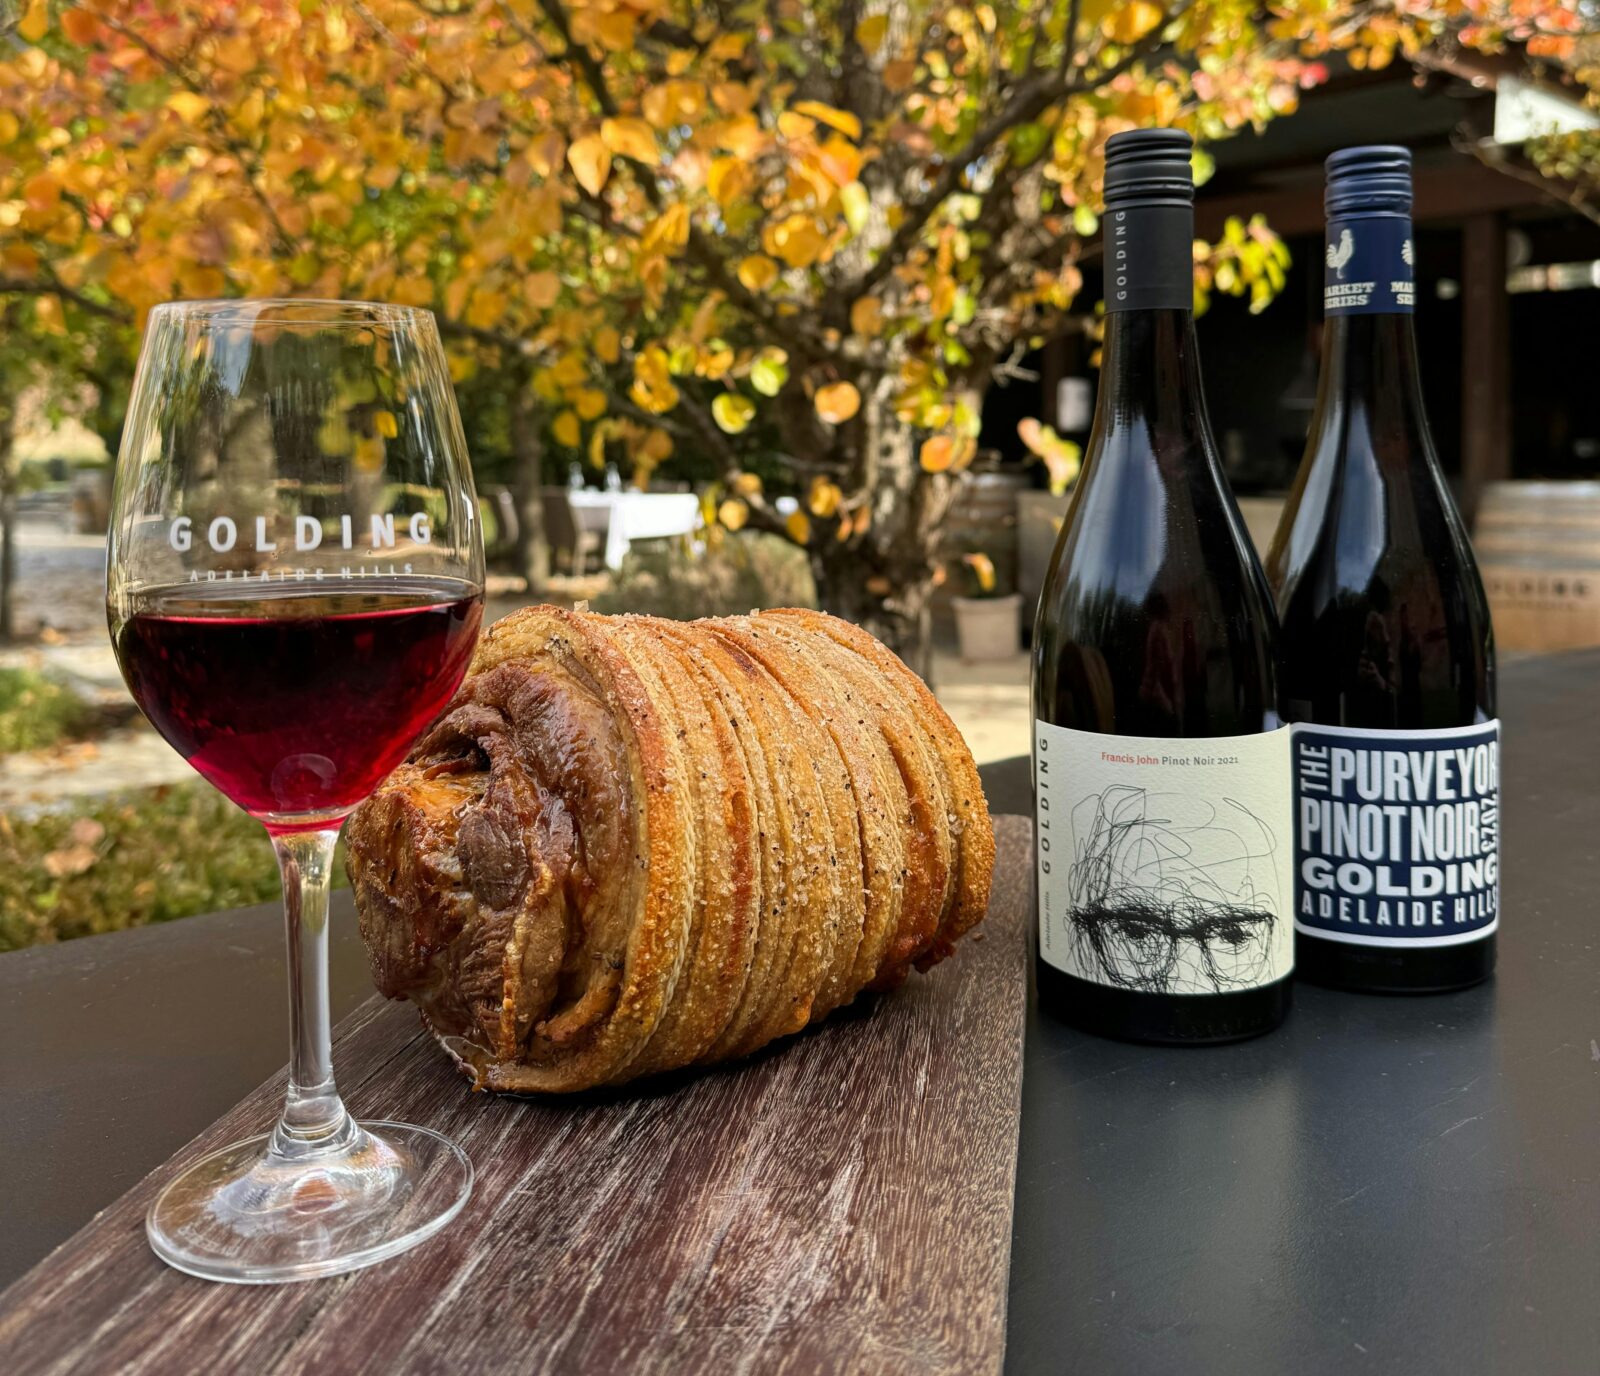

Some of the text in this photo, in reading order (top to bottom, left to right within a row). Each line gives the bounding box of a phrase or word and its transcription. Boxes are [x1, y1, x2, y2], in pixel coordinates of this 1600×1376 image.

[1115, 210, 1128, 301] GOLDING
[1324, 282, 1376, 298] ARKET
[1324, 294, 1369, 310] ERIES
[169, 511, 431, 553] GOLDING
[189, 562, 413, 583] ADELAIDE HILLS
[1101, 751, 1240, 766] Francis John Pinot Noir 2021
[1300, 740, 1497, 801] THE PURVEYOR
[1038, 737, 1051, 875] GOLDING
[1301, 796, 1481, 862] PINOT NOIR
[1301, 852, 1497, 897] GOLDING
[1301, 885, 1497, 927] ADELAIDE HILLS
